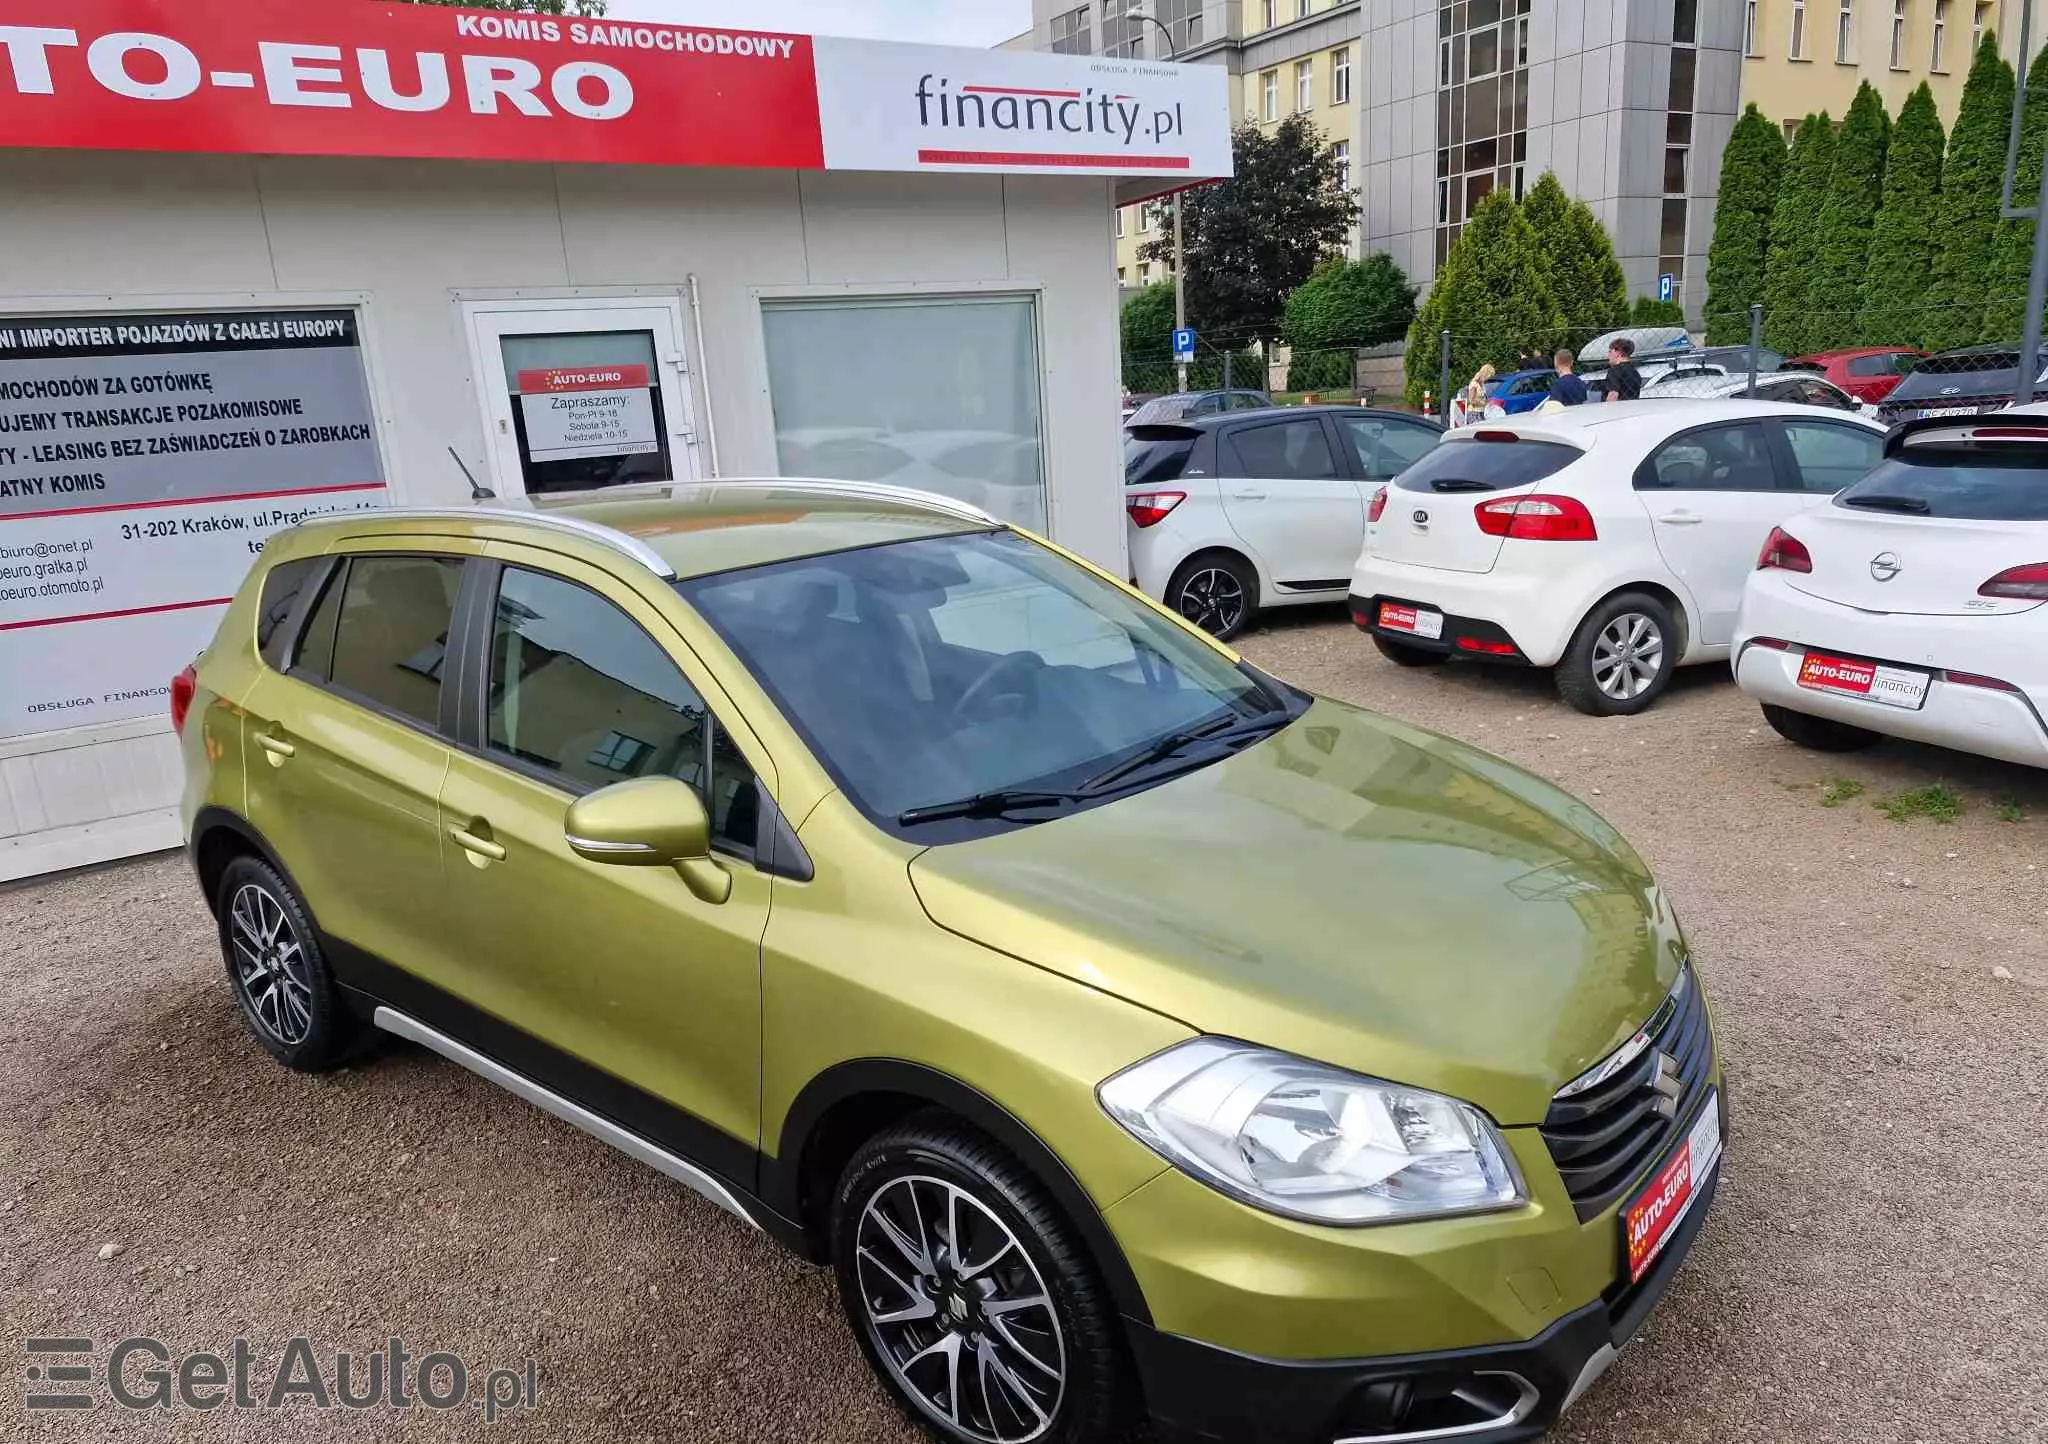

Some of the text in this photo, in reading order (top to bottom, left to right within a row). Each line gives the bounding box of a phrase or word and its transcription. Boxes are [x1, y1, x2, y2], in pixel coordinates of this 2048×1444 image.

[455, 14, 795, 59] KOMIS SAMOCHODOWY
[915, 74, 1183, 145] financity.pl
[20, 327, 114, 348] IMPORTER
[117, 320, 210, 345] POJAZDÓW
[213, 323, 226, 341] Z
[229, 321, 279, 341] CAŁEJ
[283, 319, 345, 339] EUROPY
[1178, 332, 1189, 350] P
[103, 377, 127, 395] ZA
[131, 370, 213, 394] GOTÓWKĘ
[553, 372, 621, 385] AUTO-EURO
[0, 398, 304, 432] UJEMY TRANSAKCJE POZAKOMISOWE
[569, 421, 599, 431] Sobota
[32, 440, 107, 462] LEASING
[111, 438, 145, 458] BEZ
[147, 427, 261, 455] ZAŚWIADCZEŃ
[265, 429, 276, 446] O
[279, 423, 371, 446] ZAROBKACH
[605, 430, 628, 439] 10-15
[0, 473, 105, 497] ATNY KOMIS
[121, 520, 178, 540] 31-202
[182, 513, 249, 535] Kraków,
[1808, 664, 1871, 684] AUTO-EURO
[27, 696, 95, 713] OBSŁUGA
[1633, 1160, 1689, 1247] AUTO-EURO
